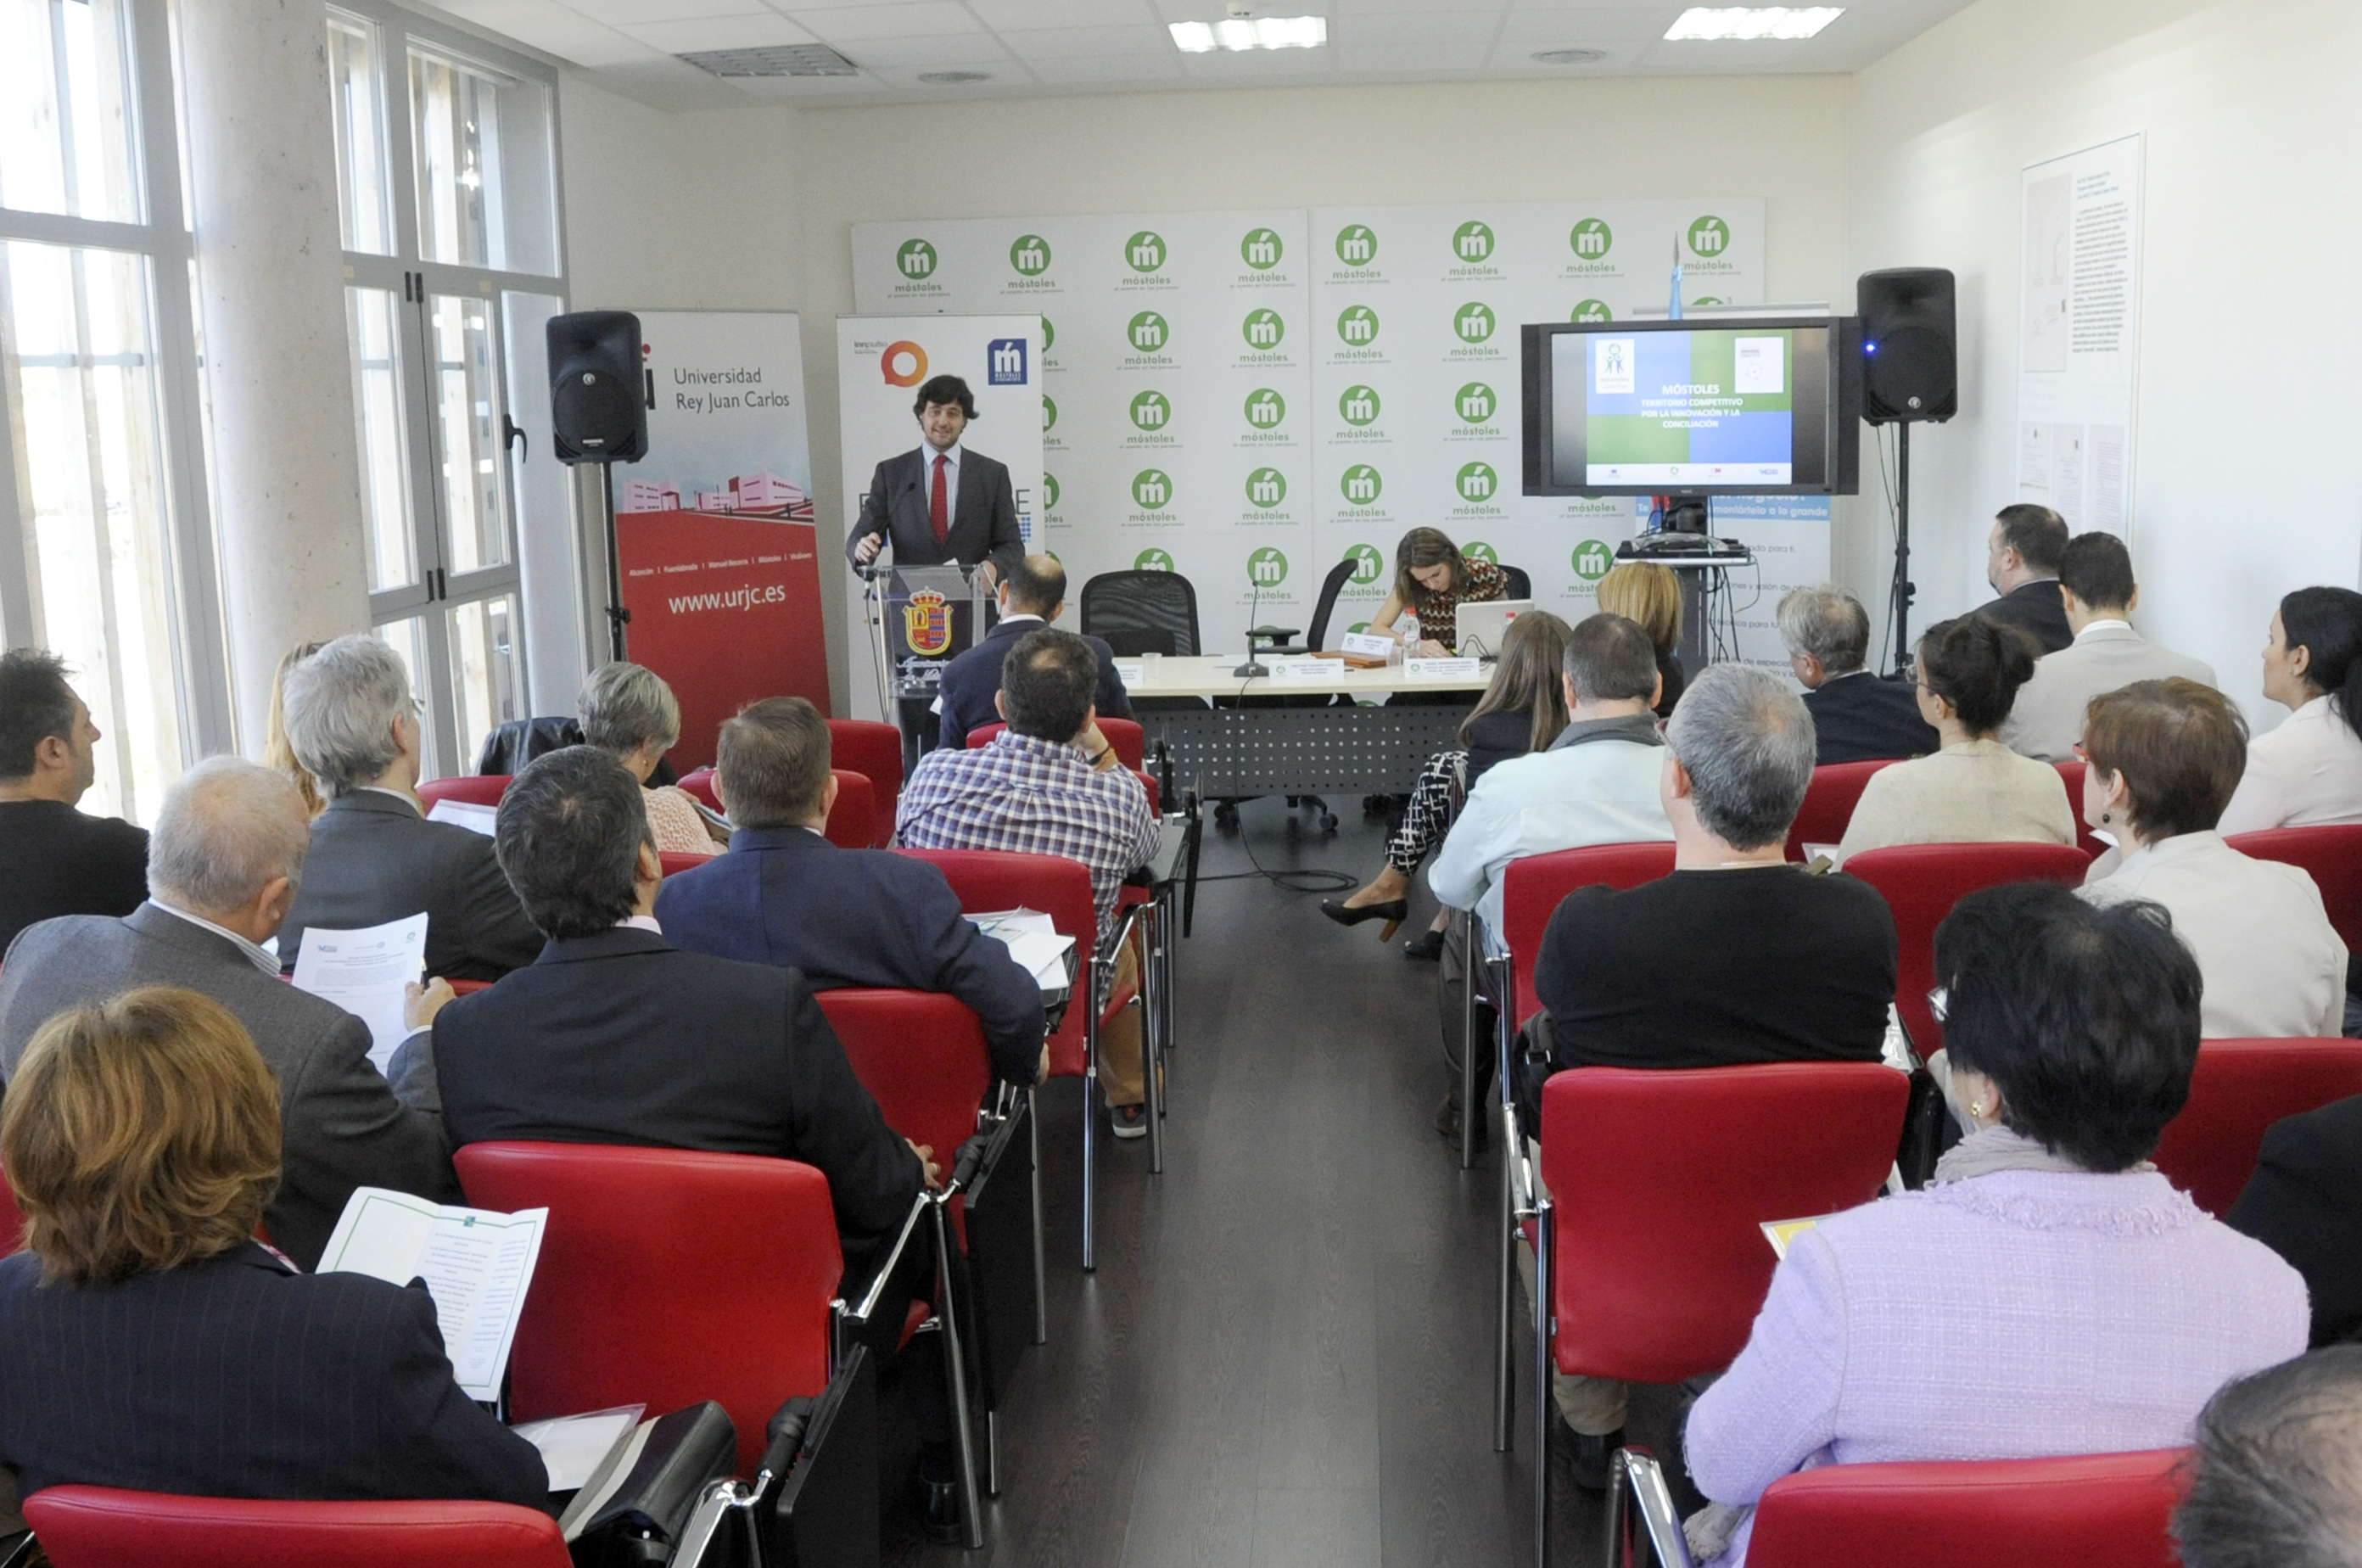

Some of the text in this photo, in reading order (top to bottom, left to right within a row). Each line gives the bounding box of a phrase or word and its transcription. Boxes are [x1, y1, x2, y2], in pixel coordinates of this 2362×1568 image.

[1567, 262, 1615, 272] móstoles
[1684, 259, 1732, 270] móstoles
[1333, 268, 1381, 278] móstoles
[1449, 266, 1497, 276] móstoles
[1122, 276, 1171, 285] móstoles
[1238, 272, 1287, 282] móstoles
[895, 283, 942, 292] móstoles
[1008, 279, 1055, 288] móstoles
[1335, 349, 1383, 359] móstoles
[1451, 345, 1499, 356] móstoles
[1125, 356, 1173, 365] móstoles
[1240, 353, 1288, 362] móstoles
[674, 367, 762, 384] Universidad
[1662, 384, 1720, 395] MÓSTOLES
[676, 390, 790, 414] Rey Juan Carlos
[1641, 397, 1744, 407] TERRITORIO COMPETITIVO
[1671, 407, 1721, 417] INNOVACIÓN
[1663, 418, 1718, 428] CONCILIACIÓN
[1336, 428, 1385, 439] móstoles
[1452, 425, 1500, 435] móstoles
[1127, 434, 1174, 443] móstoles
[1241, 433, 1289, 441] móstoles
[1338, 507, 1385, 517] móstoles
[1452, 504, 1501, 514] móstoles
[1568, 503, 1615, 512] móstoles
[1637, 503, 1648, 512] Te
[1778, 506, 1788, 515] lo
[1790, 506, 1828, 518] grande
[1129, 512, 1176, 521] móstoles
[1242, 510, 1290, 520] móstoles
[1568, 584, 1596, 592] móst
[669, 584, 786, 613] www.urjc.es
